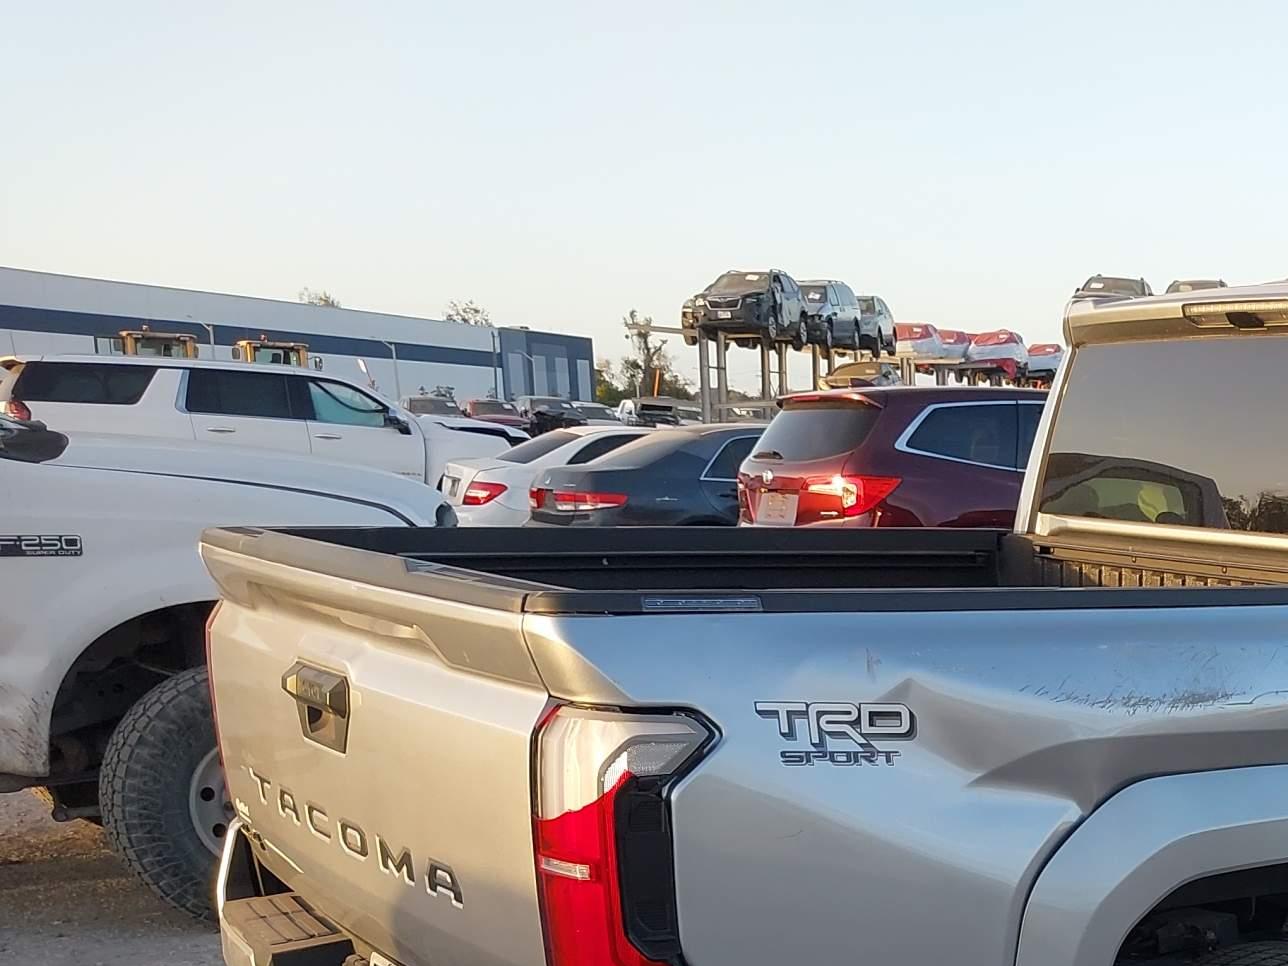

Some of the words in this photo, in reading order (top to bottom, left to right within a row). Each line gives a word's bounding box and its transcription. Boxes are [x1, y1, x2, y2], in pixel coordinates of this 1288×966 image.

[754, 701, 918, 751] TRD
[780, 750, 902, 767] SPORT
[241, 764, 464, 909] TACOMA
